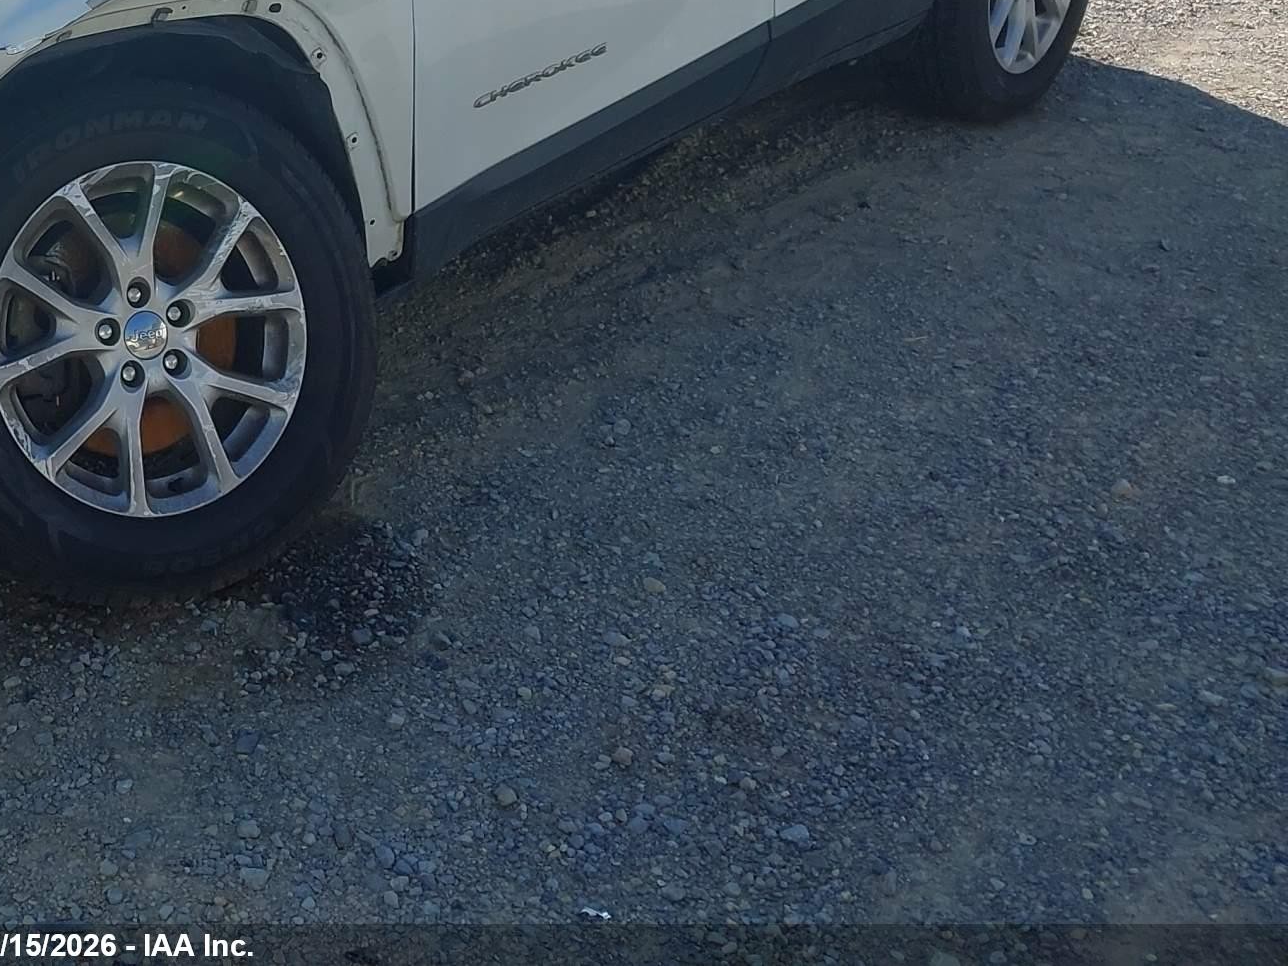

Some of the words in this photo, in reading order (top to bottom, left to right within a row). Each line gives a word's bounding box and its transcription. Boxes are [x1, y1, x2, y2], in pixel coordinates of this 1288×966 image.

[473, 42, 608, 108] CHEROKEE
[11, 108, 209, 184] IRONMAN
[130, 329, 164, 343] Jeep
